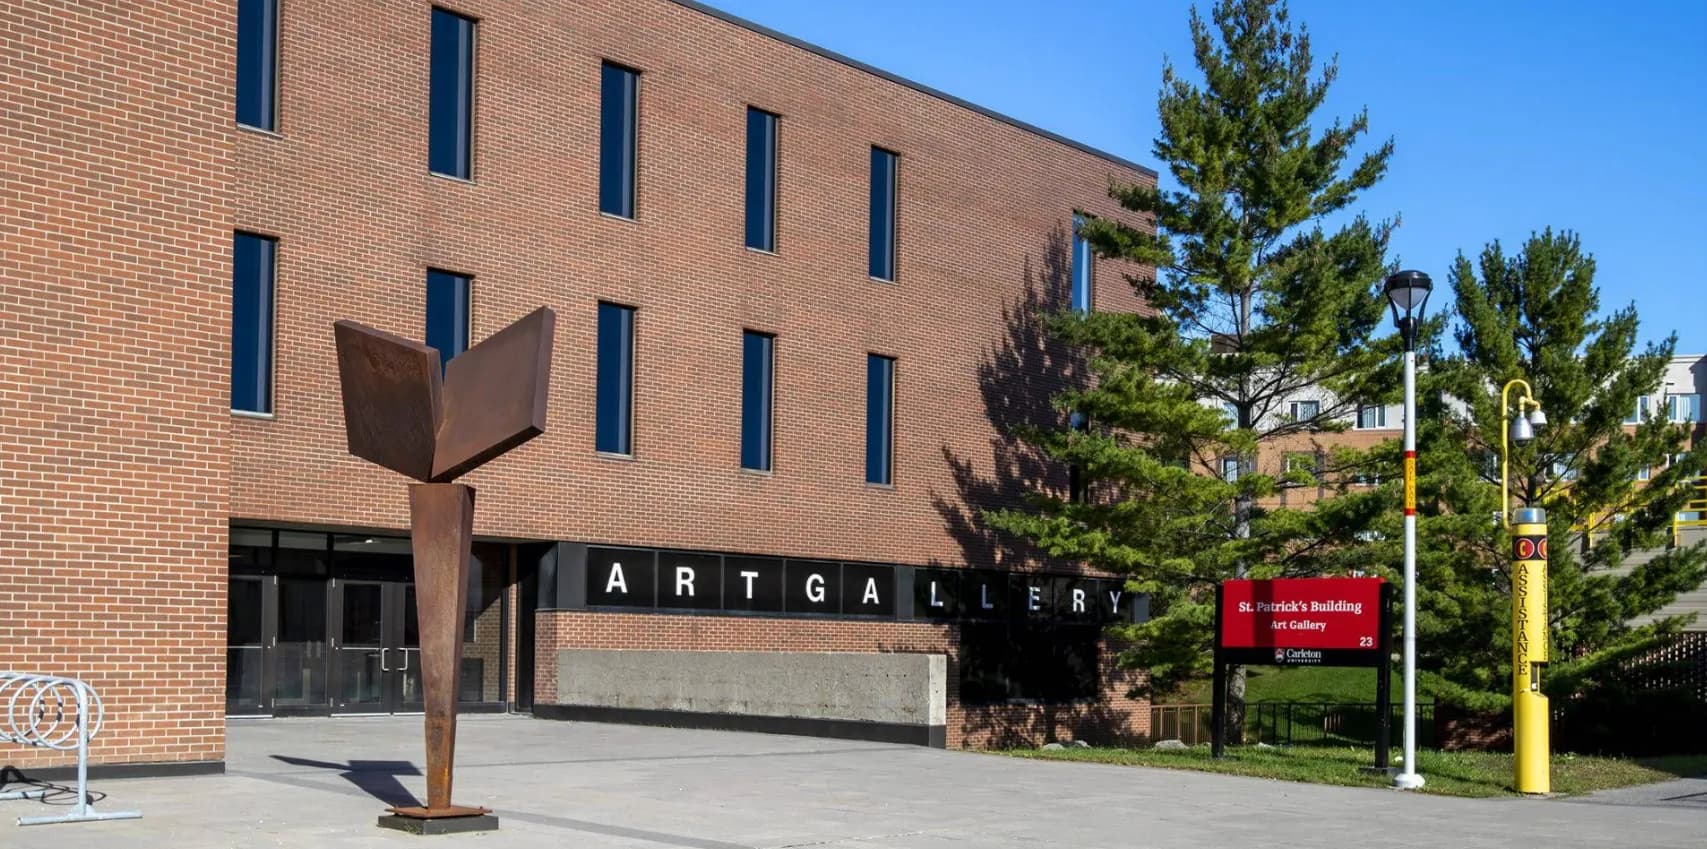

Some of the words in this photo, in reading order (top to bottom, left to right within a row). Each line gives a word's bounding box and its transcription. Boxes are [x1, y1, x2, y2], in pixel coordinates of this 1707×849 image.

[1519, 541, 1526, 556] C
[605, 562, 759, 599] ART
[805, 573, 1121, 614] GALLERY
[1238, 601, 1254, 613] St.
[1256, 600, 1307, 613] Patrick's
[1310, 600, 1362, 615] Building
[1271, 620, 1287, 630] Art
[1289, 620, 1327, 632] Gallery
[1517, 563, 1529, 676] ASSISTANCE
[1359, 636, 1373, 647] 23
[1286, 648, 1321, 658] Carleton
